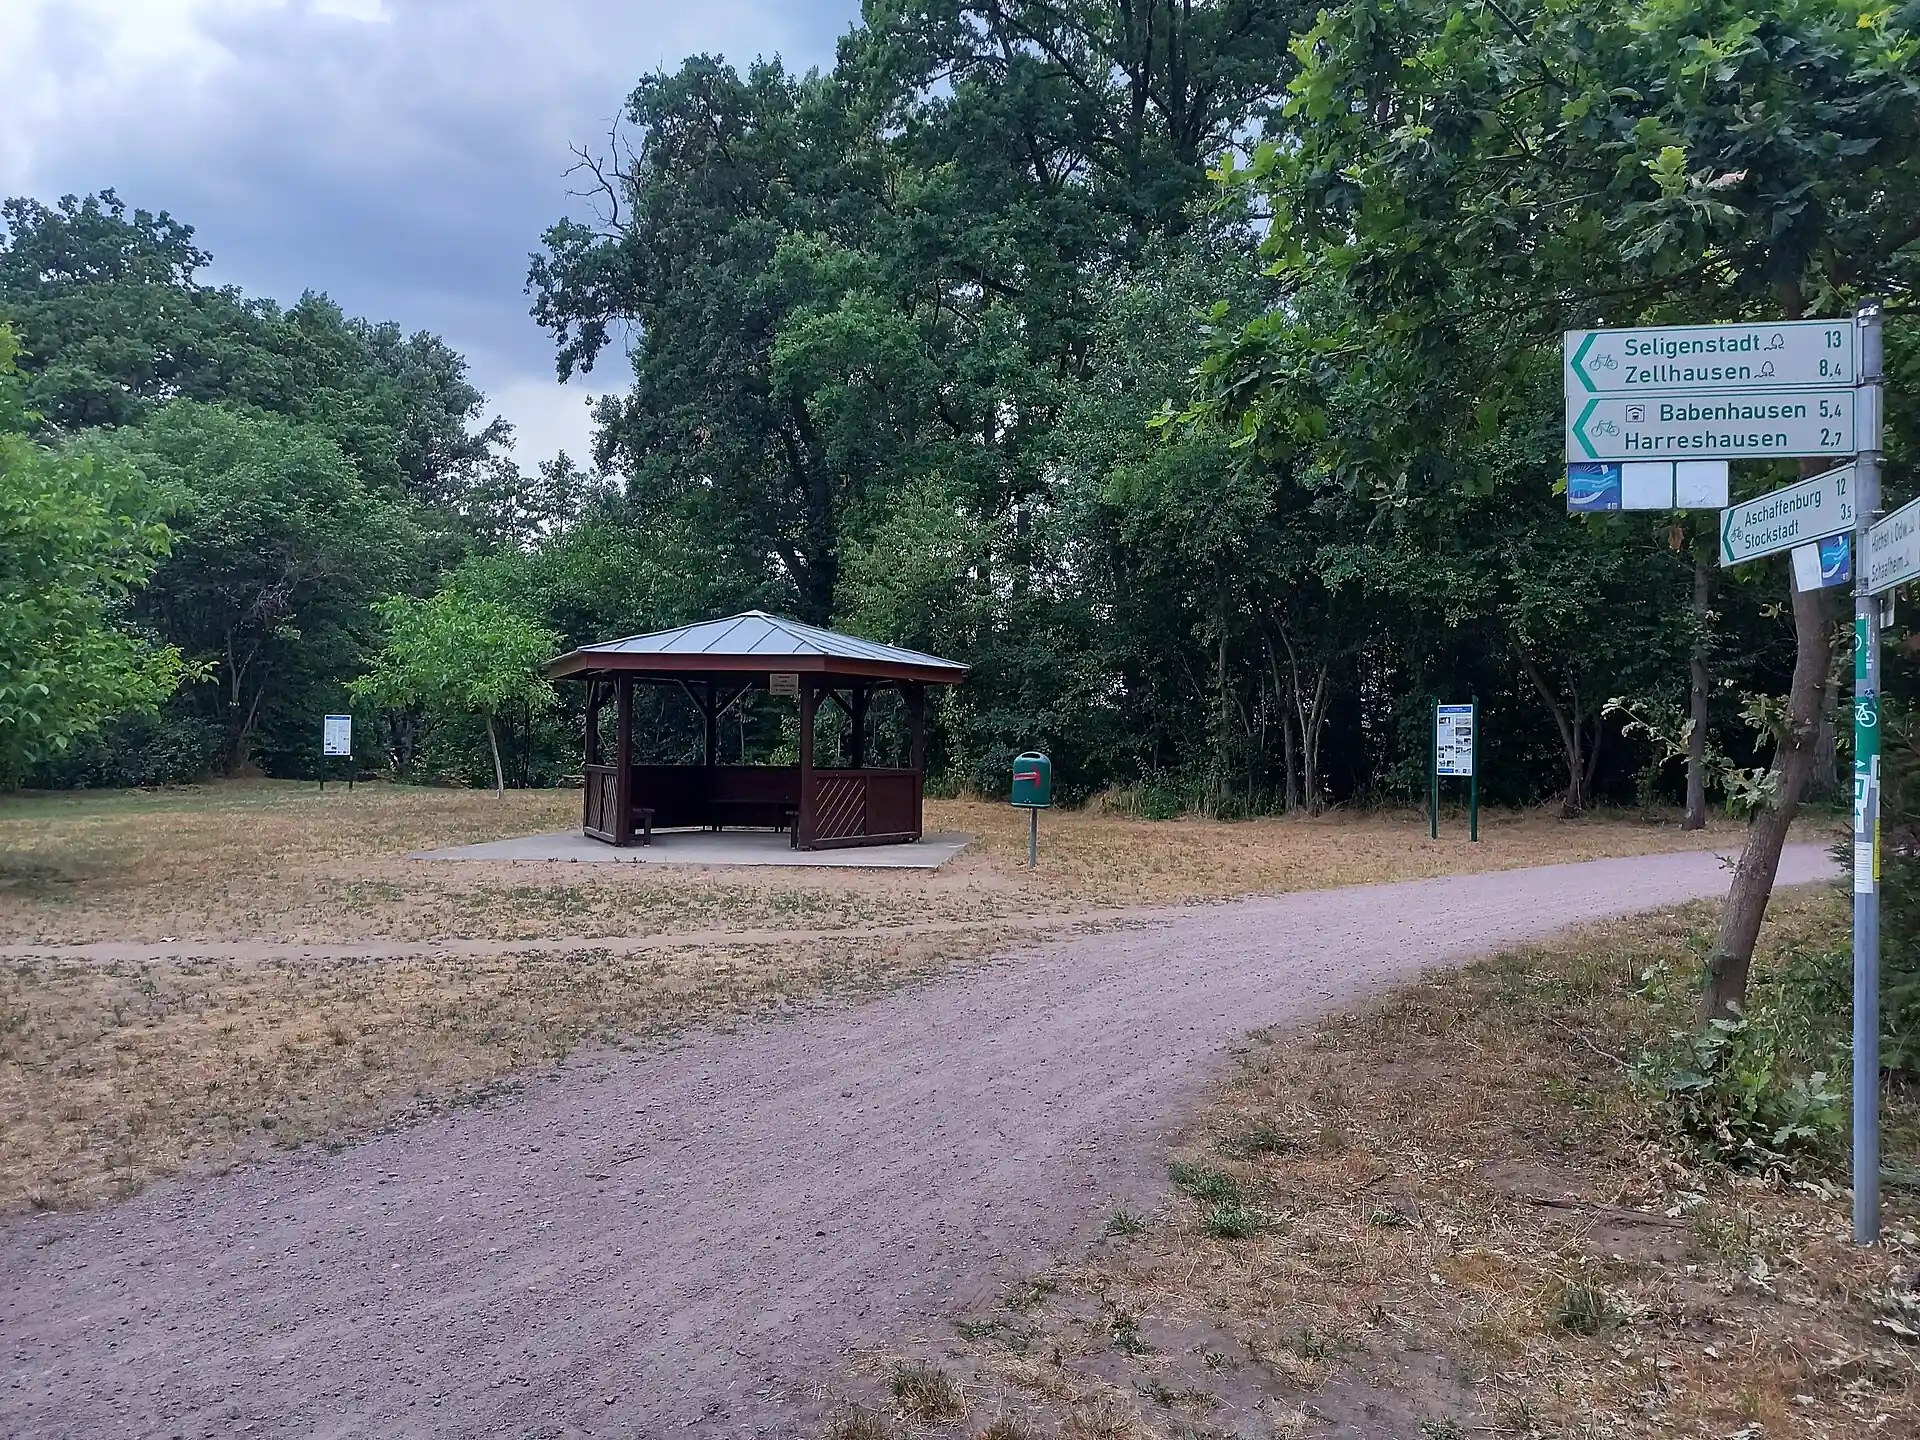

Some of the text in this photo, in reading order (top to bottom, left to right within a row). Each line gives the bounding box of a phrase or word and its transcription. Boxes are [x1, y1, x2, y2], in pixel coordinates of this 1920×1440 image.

[1625, 330, 1842, 359] Seligenstadt 13
[1625, 359, 1842, 383] Zellhausen 8,4
[1660, 400, 1842, 421] Babenhausen 5,4
[1625, 428, 1842, 450] Harreshausen 2,7
[1744, 478, 1846, 527] Aschaffenburg 12
[1744, 519, 1799, 549] Stockstadt
